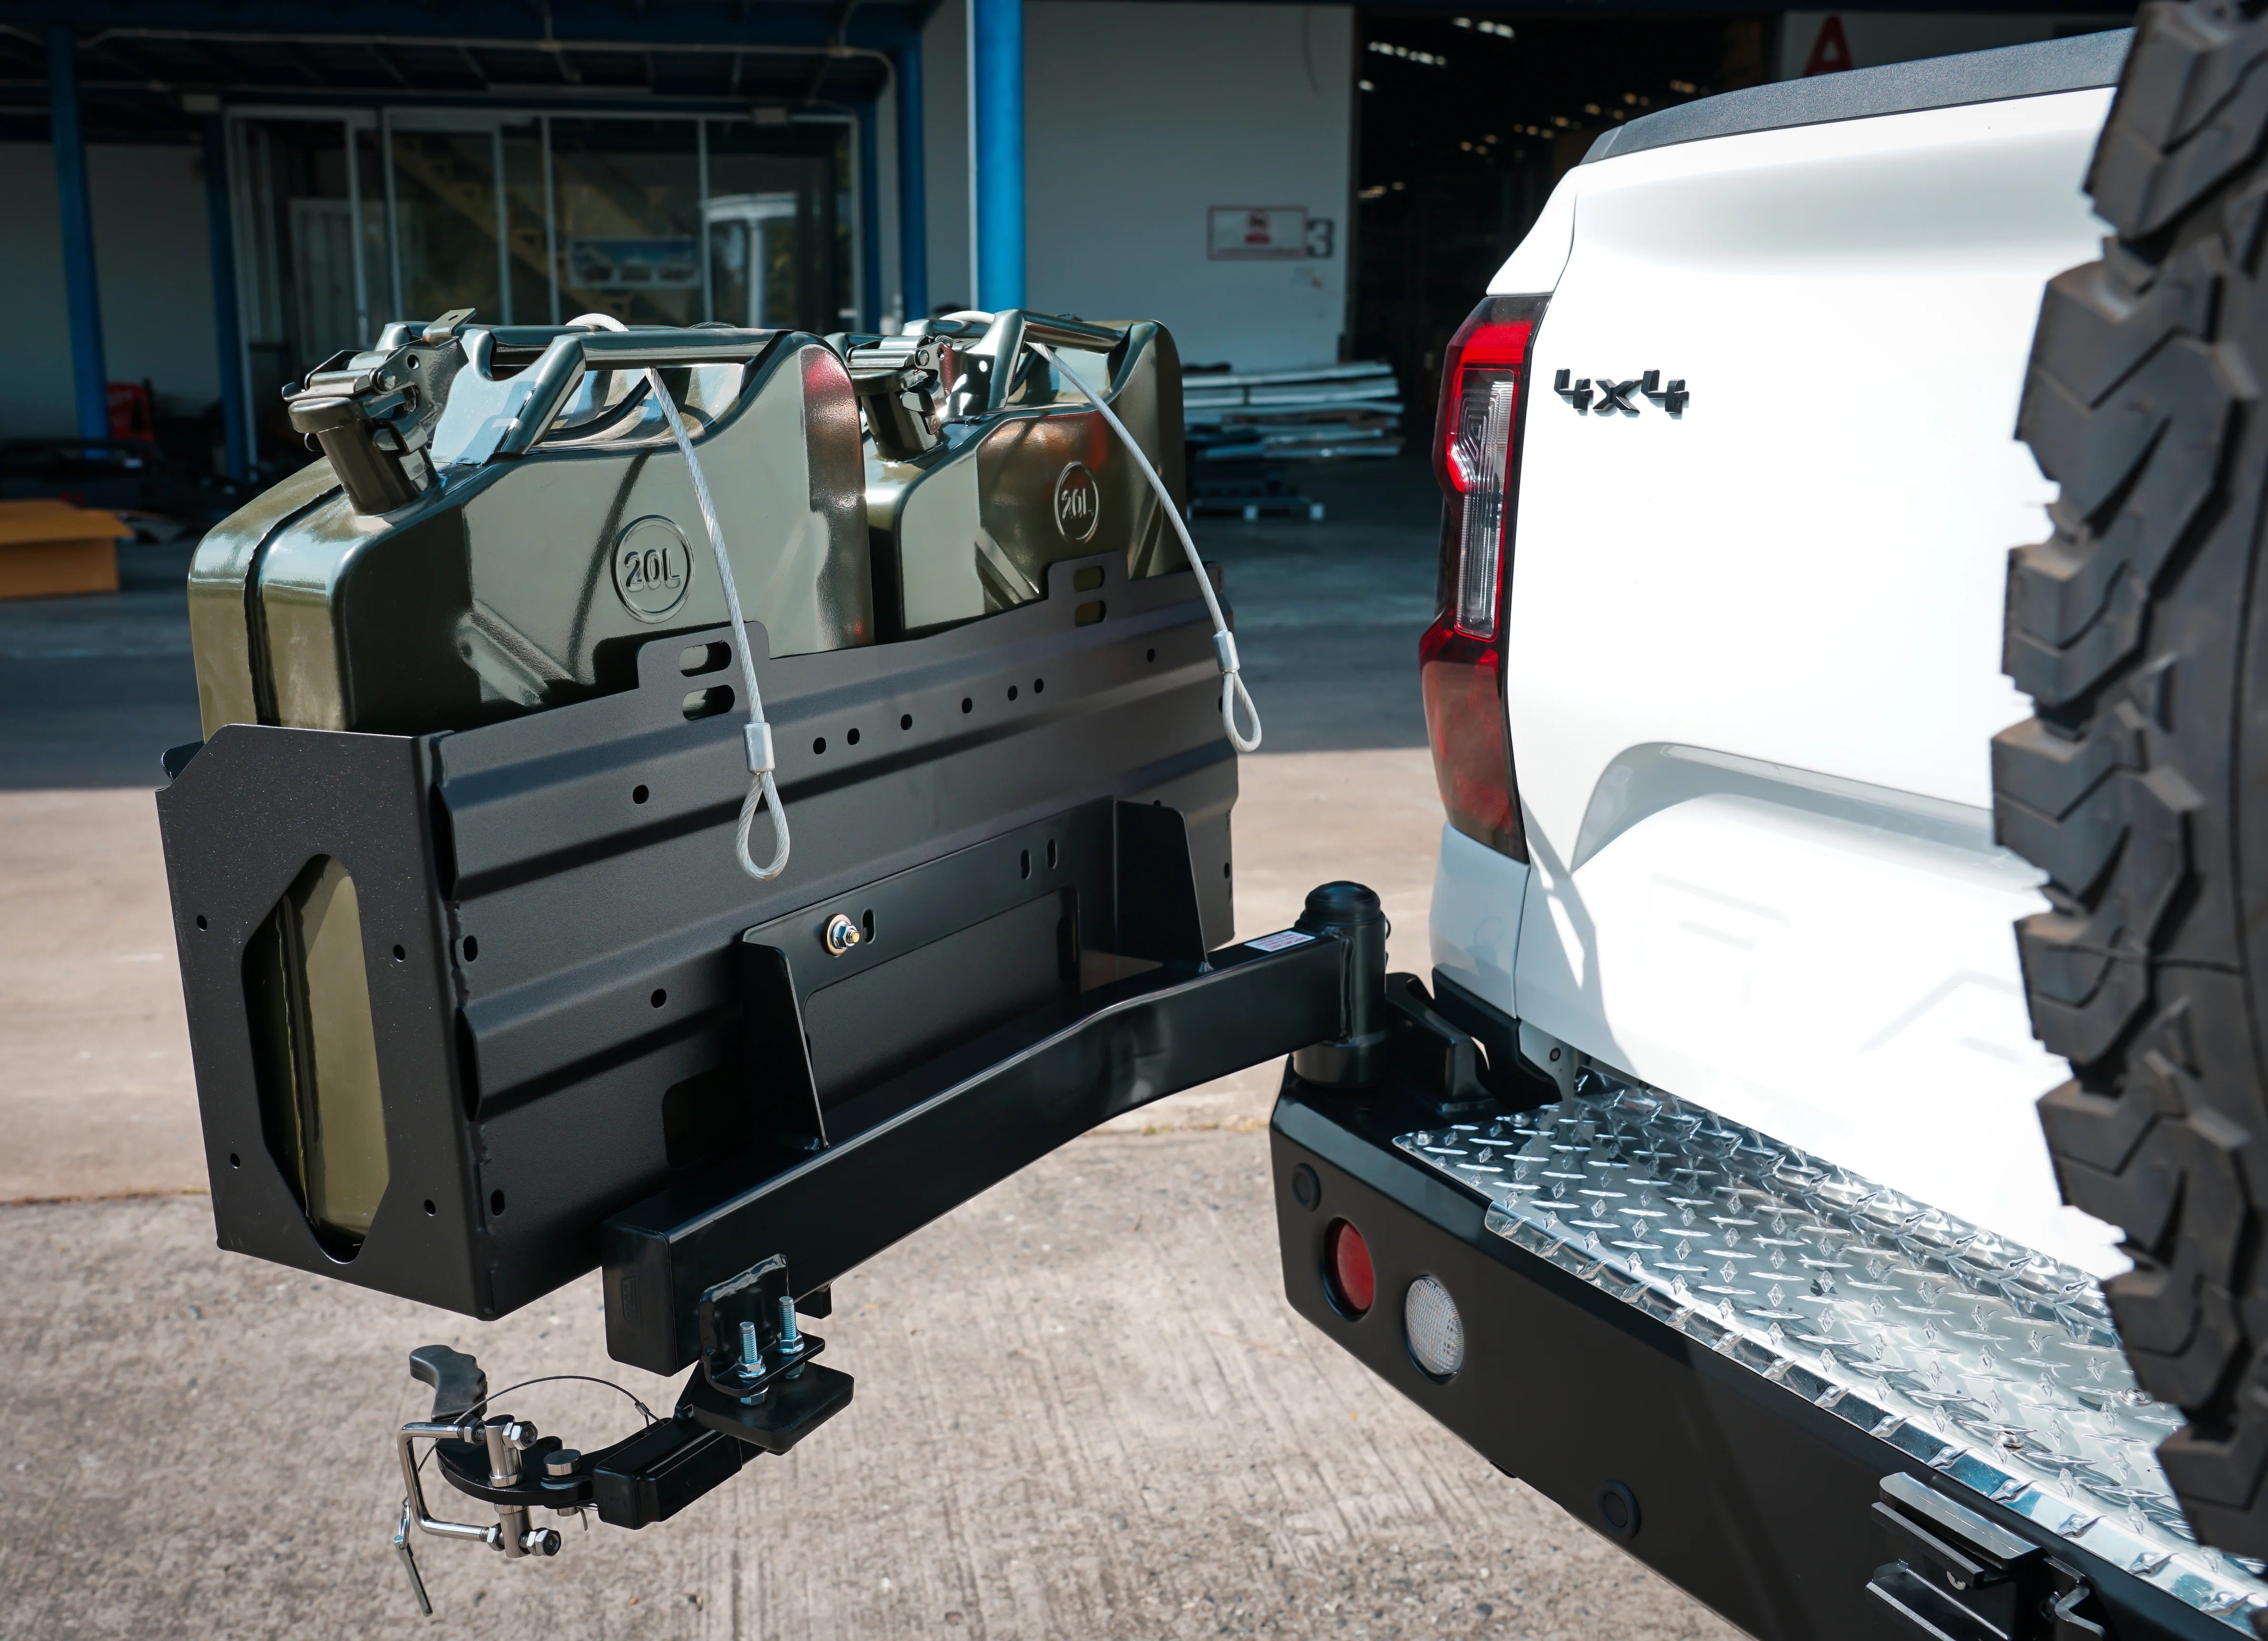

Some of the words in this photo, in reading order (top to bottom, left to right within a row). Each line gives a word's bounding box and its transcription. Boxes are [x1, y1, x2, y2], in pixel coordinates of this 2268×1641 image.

[1306, 217, 1334, 258] 3
[1061, 488, 1093, 519] 20L
[624, 548, 681, 592] 20L
